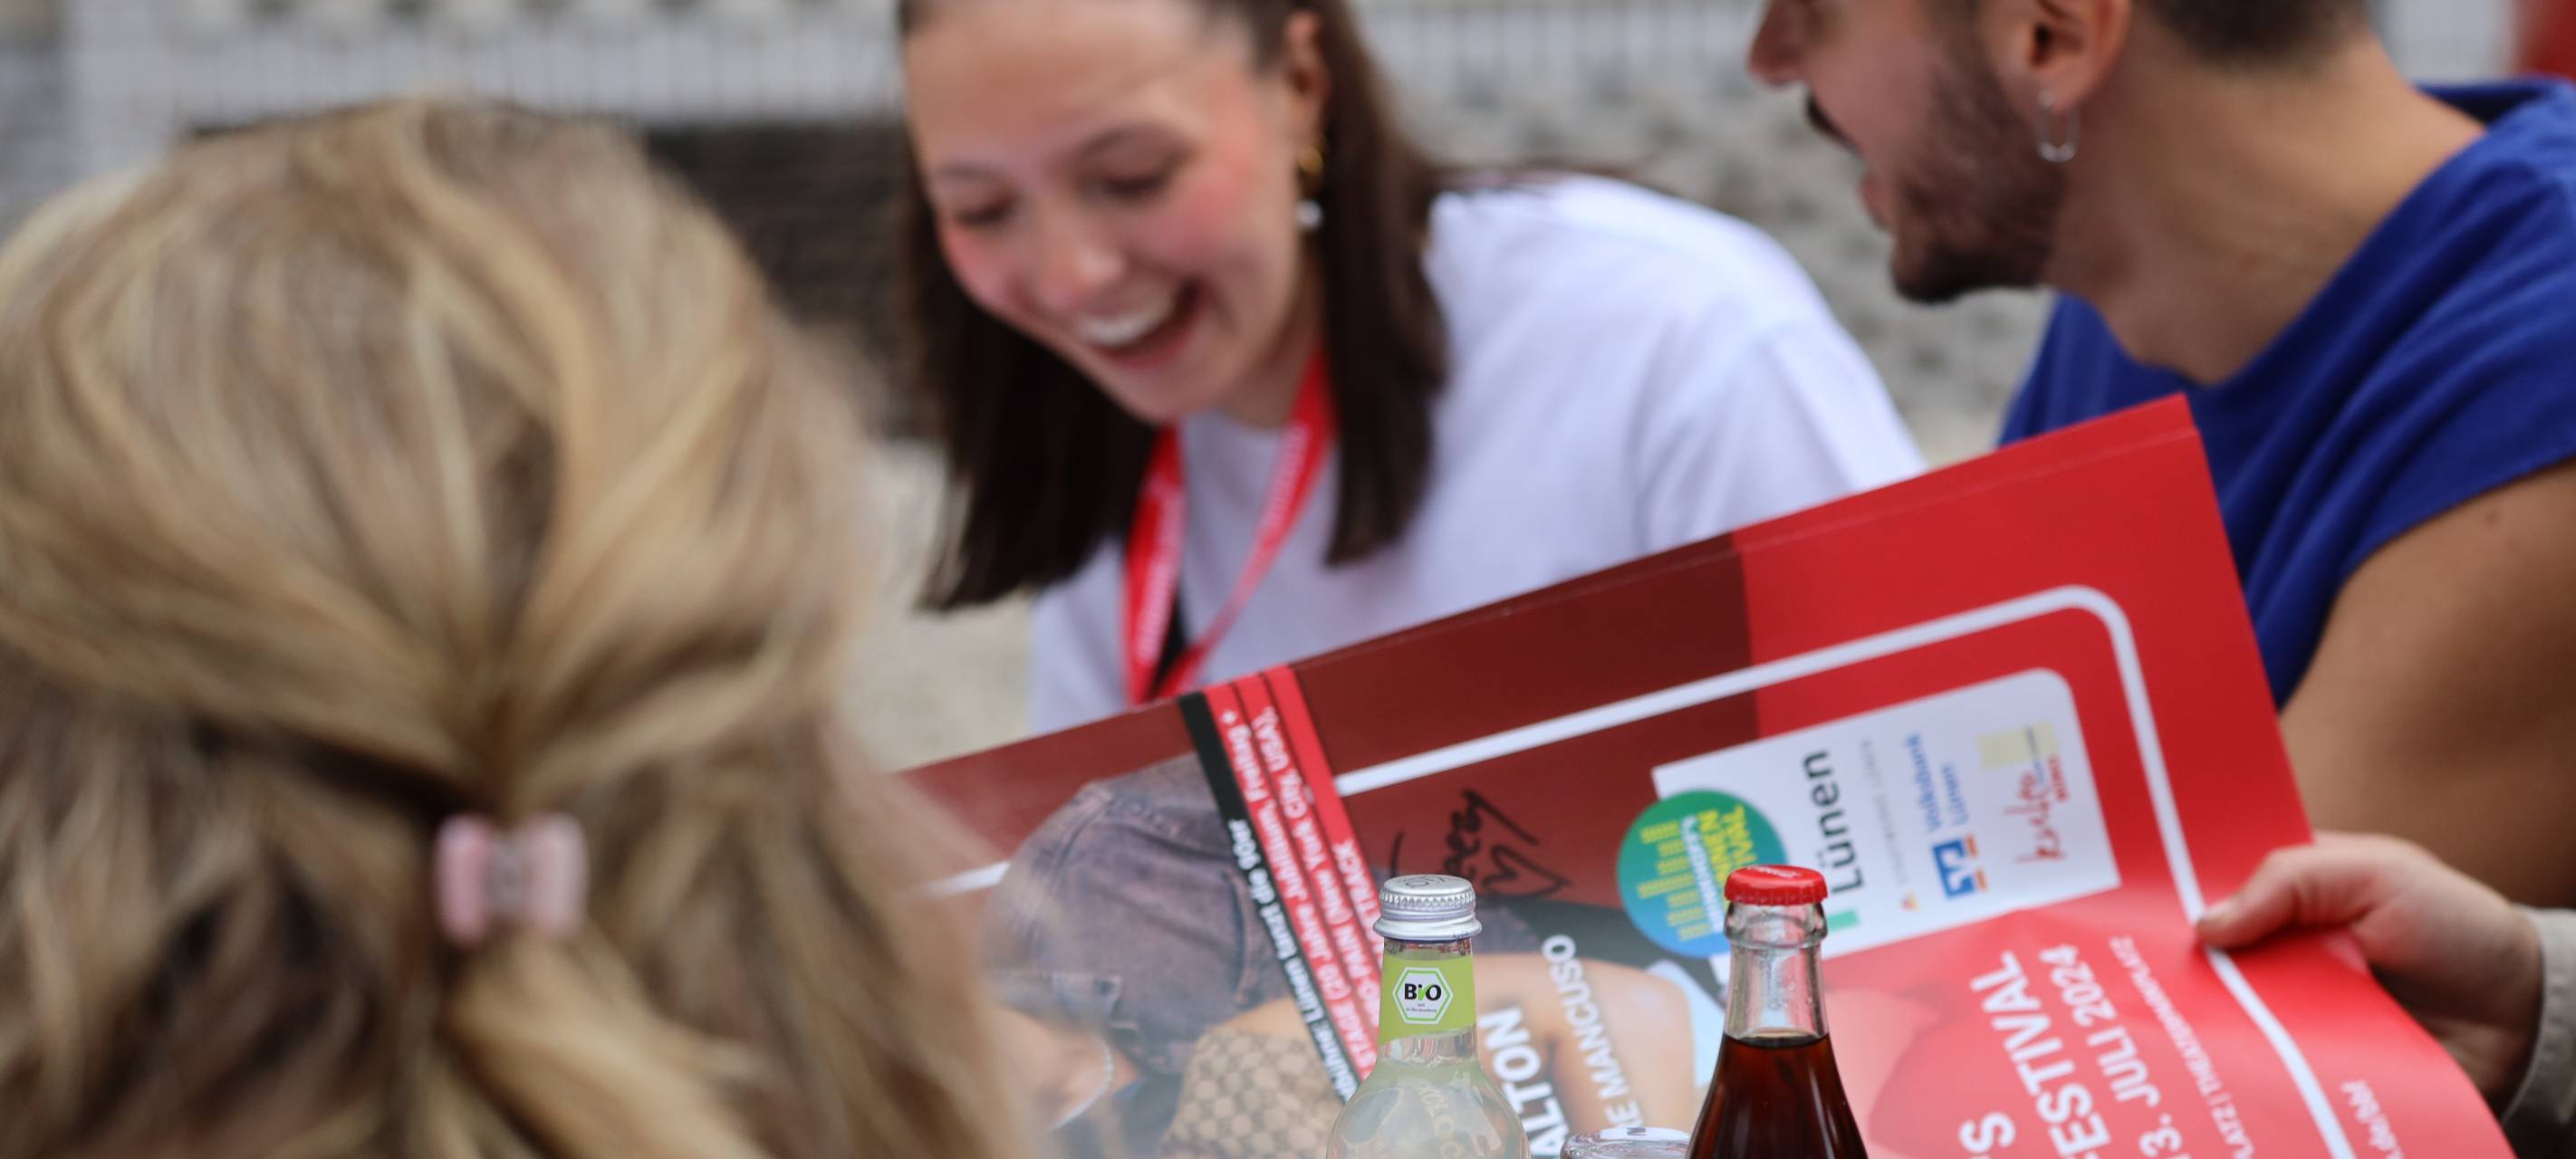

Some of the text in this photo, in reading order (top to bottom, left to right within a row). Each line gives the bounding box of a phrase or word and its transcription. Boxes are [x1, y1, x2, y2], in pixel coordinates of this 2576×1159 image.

[1228, 725, 1267, 800] Freitag
[1904, 733, 1942, 832] Volksbank
[1938, 762, 1970, 826] Lünen
[1229, 820, 1260, 868] 90er
[1258, 800, 1307, 901] Jubiläum,
[1293, 819, 1325, 870] York
[1802, 749, 1863, 896] Lünen
[1248, 869, 1275, 904] die
[1316, 869, 1351, 925] (New
[1260, 904, 1297, 960] tanzt
[1296, 904, 1333, 963] Jahre
[1284, 959, 1329, 1024] Lünen
[1542, 934, 1629, 1099] MANCUSO
[1330, 999, 1377, 1074] STAGE
[1970, 952, 2110, 1159] ESTIVAL
[2040, 946, 2188, 1159] 3. JULI 2024
